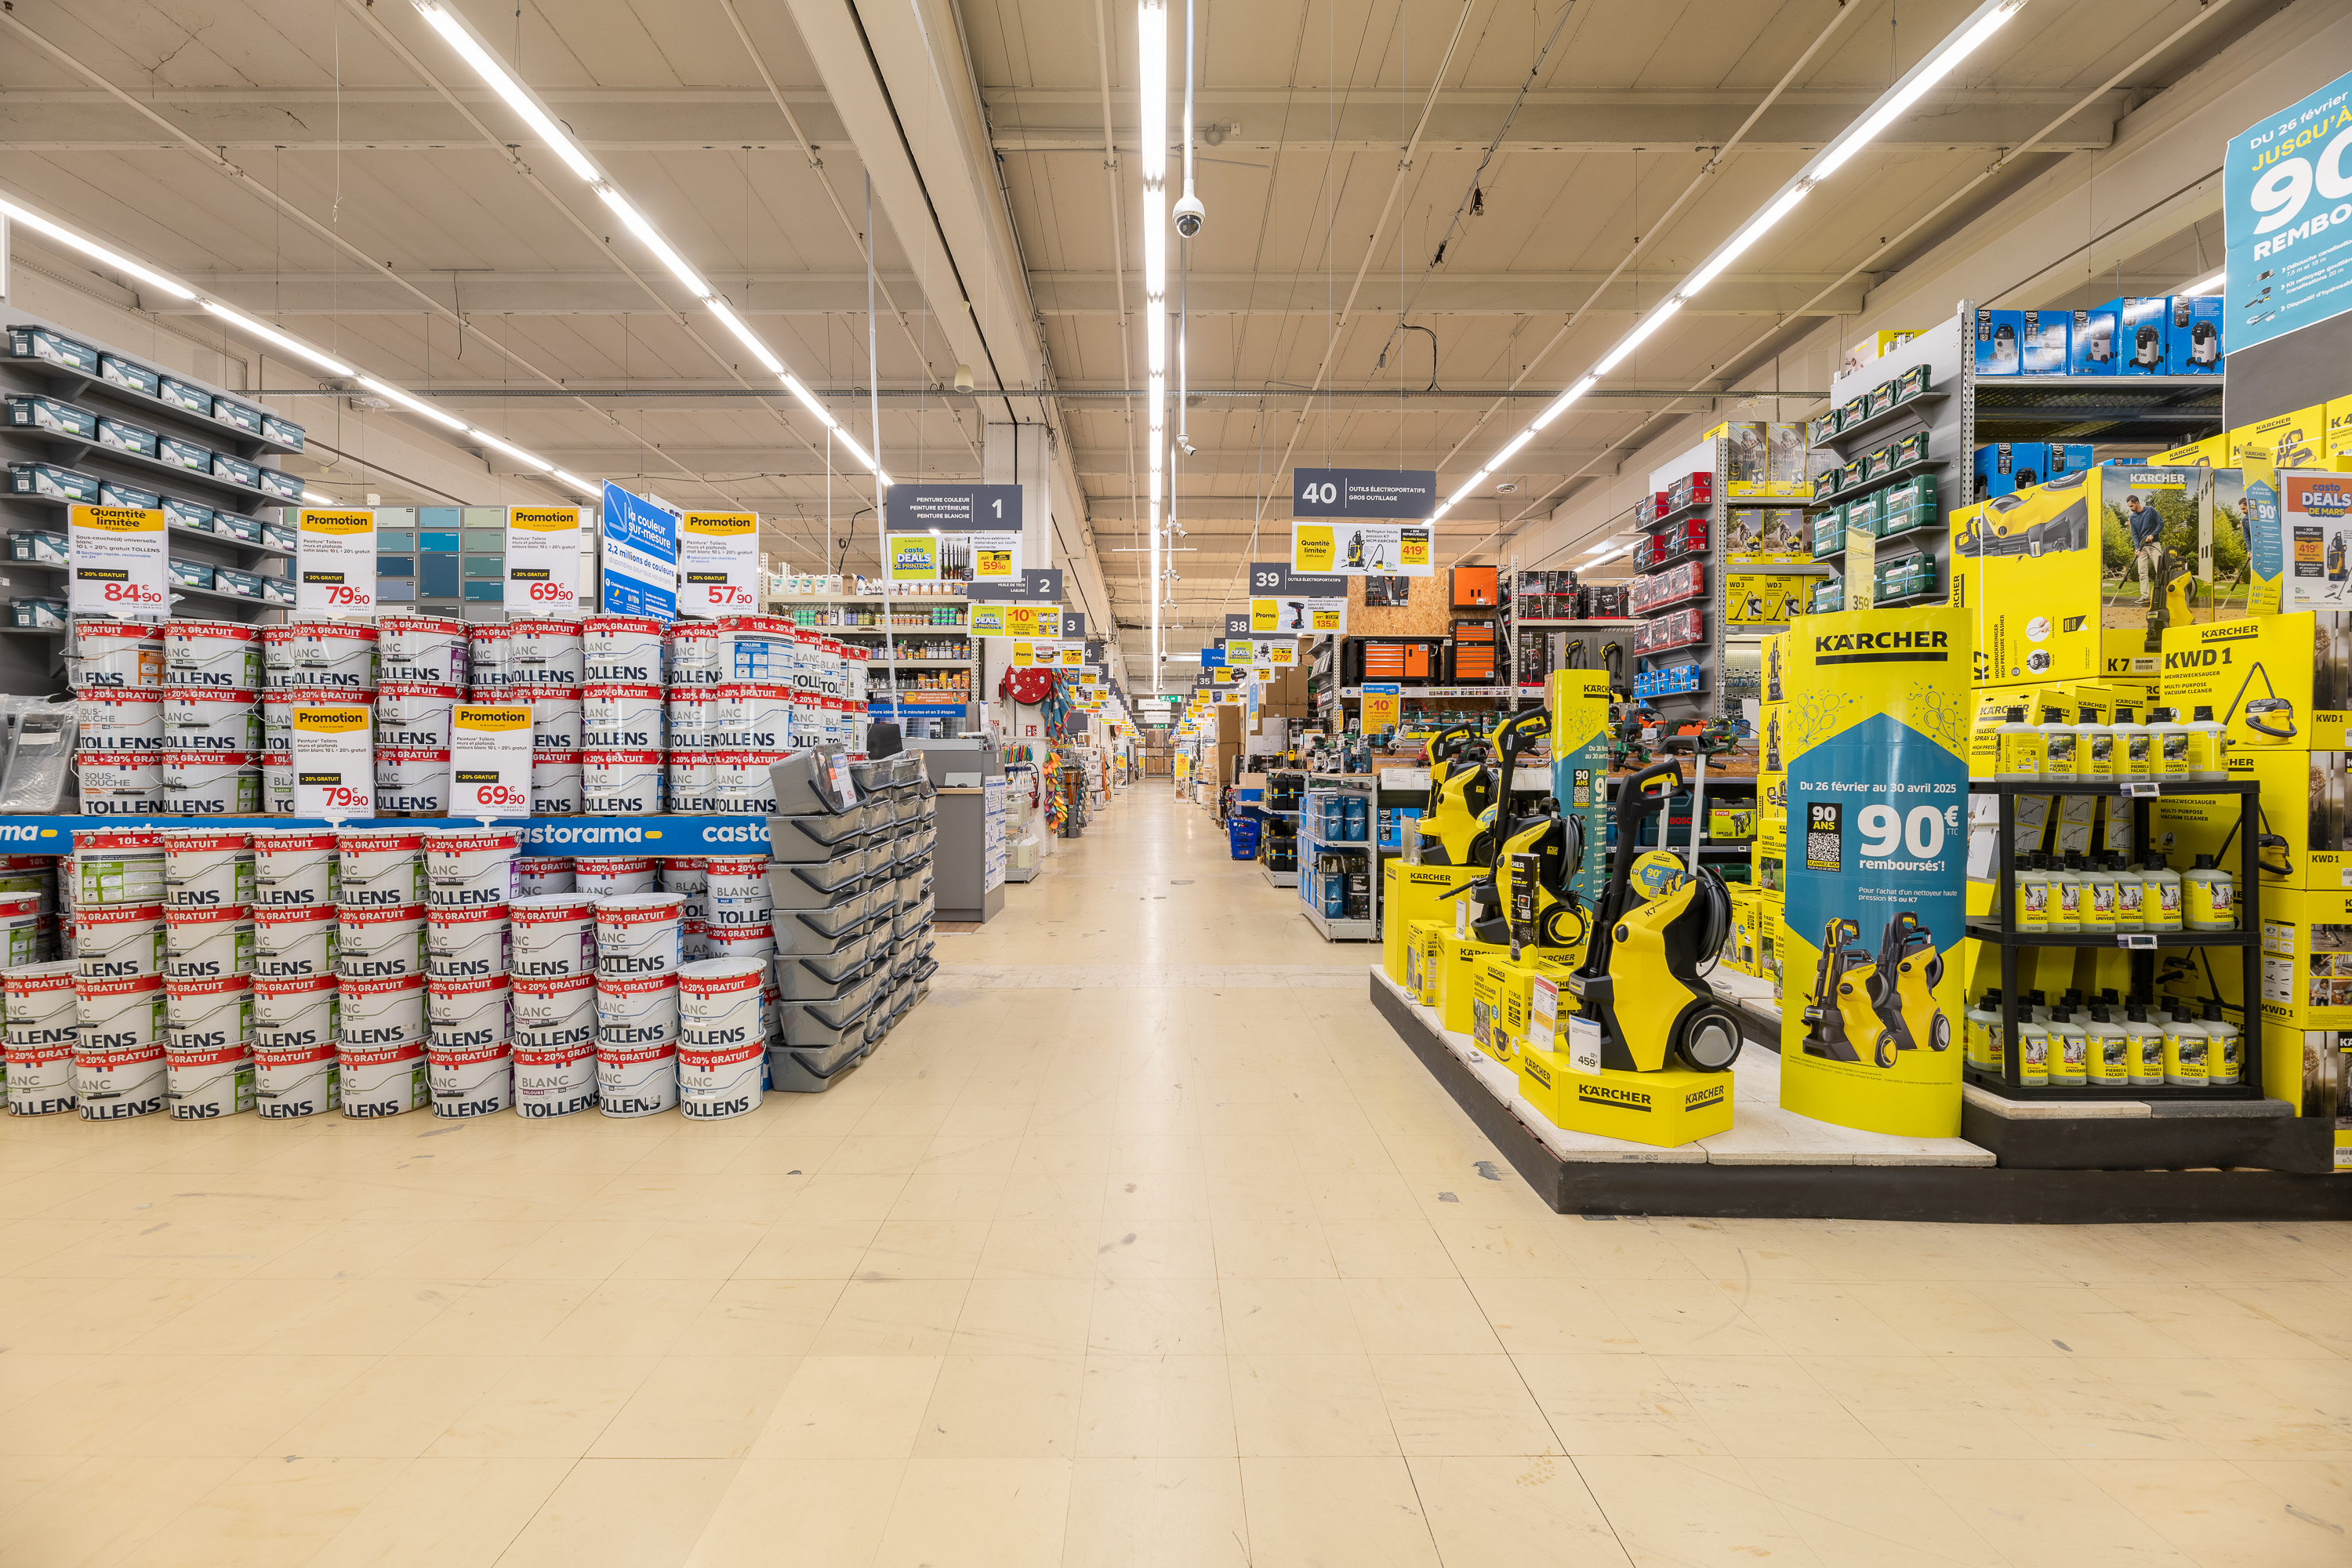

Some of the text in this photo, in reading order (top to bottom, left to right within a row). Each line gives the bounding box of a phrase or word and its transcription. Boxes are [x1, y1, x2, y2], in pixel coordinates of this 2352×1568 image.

[2250, 92, 2348, 149] DU 26 février
[2287, 239, 2352, 270] Débouche canalisatio
[2256, 417, 2291, 431] KÄRCHER
[2130, 474, 2185, 482] KÄRCHER
[1302, 483, 1337, 503] 40
[2302, 492, 2351, 506] DEALS
[90, 508, 146, 518] Quantité
[992, 499, 1001, 518] 1
[96, 517, 140, 527] limitée
[307, 515, 367, 525] Promotion
[516, 512, 573, 521] Promotion
[628, 507, 666, 532] la couleur
[691, 517, 750, 526] Promotion
[629, 521, 670, 549] sur-mesure
[1403, 546, 1426, 555] 419€
[2299, 544, 2318, 553] 419€
[608, 543, 618, 554] 2,2
[619, 550, 643, 564] millions
[644, 558, 651, 568] de
[653, 564, 673, 577] couleurs
[897, 554, 931, 562] DEALS
[1256, 572, 1279, 586] 39
[1040, 579, 1050, 592] 2
[1067, 620, 1076, 631] 3
[1230, 621, 1247, 631] 38
[2201, 625, 2259, 639] KÄRCHER
[1816, 631, 1948, 652] KÄRCHER
[2165, 648, 2232, 669] KWD 1
[461, 711, 524, 721] Promotion
[81, 737, 163, 749] TOLLENS
[1800, 782, 1813, 790] Du
[1831, 782, 1870, 792] février
[1890, 783, 1904, 793] 30
[1907, 783, 1931, 793] avril
[1934, 784, 1956, 793] 2025
[1813, 806, 1836, 821] 90
[1813, 822, 1835, 830] ANS
[521, 824, 641, 843] astorama
[1410, 873, 1450, 881] KÄRCHER
[717, 887, 759, 896] BLANC
[1645, 906, 1656, 917] K7
[1488, 966, 1504, 978] KÄRCHER
[1525, 1056, 1551, 1083] KÄRCHER
[522, 1075, 569, 1087] BLANC
[1579, 1083, 1651, 1105] KÄRCHER
[1686, 1085, 1724, 1104] KÄRCHER
